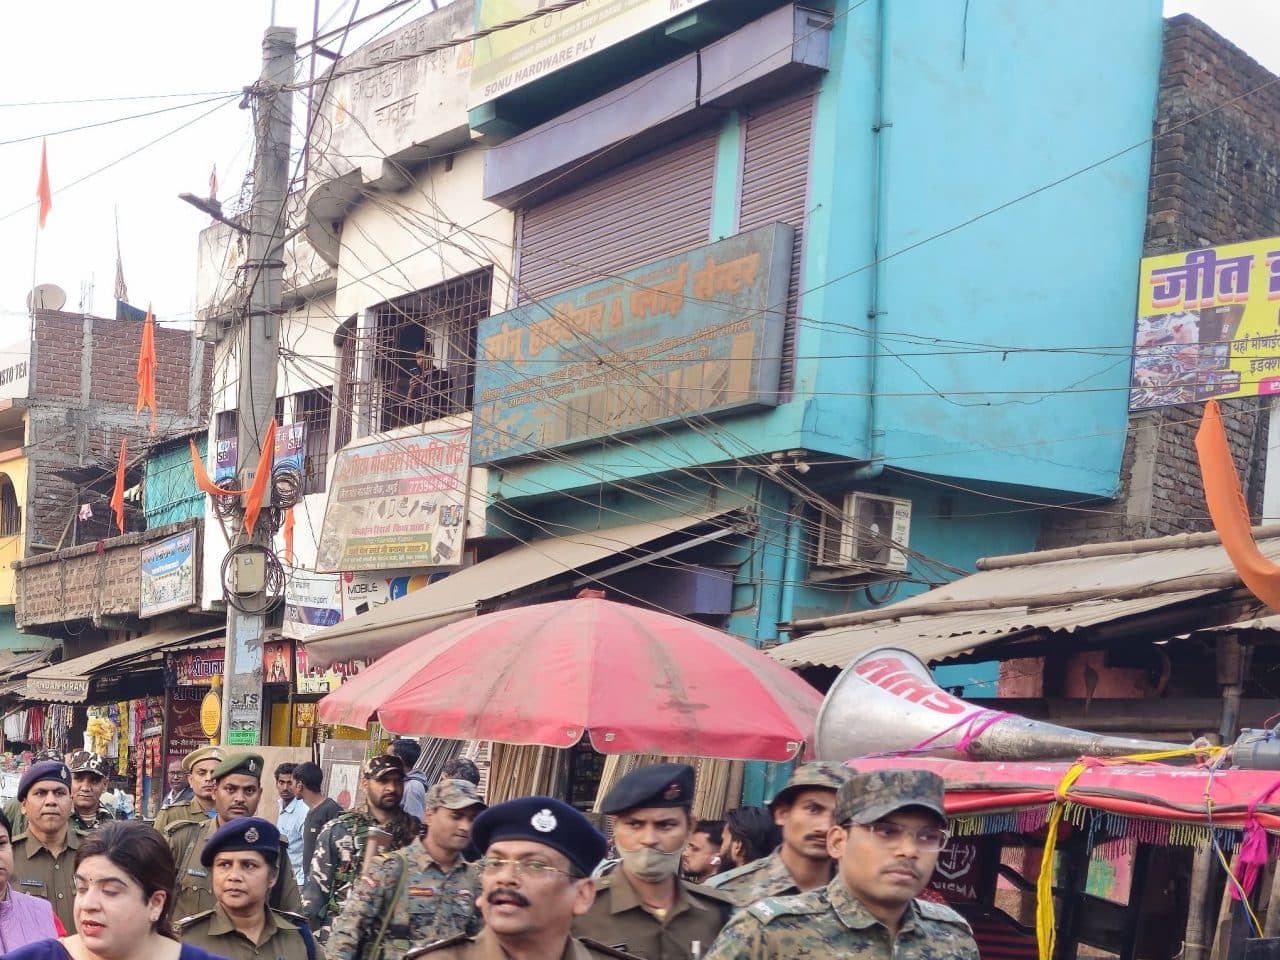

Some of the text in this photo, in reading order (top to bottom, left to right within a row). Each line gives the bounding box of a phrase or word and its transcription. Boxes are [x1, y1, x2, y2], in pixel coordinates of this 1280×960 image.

[484, 36, 599, 97] SONU HARDWARE PLY
[1151, 249, 1254, 308] जीत
[15, 361, 27, 380] TEA
[347, 582, 378, 595] MOBILE
